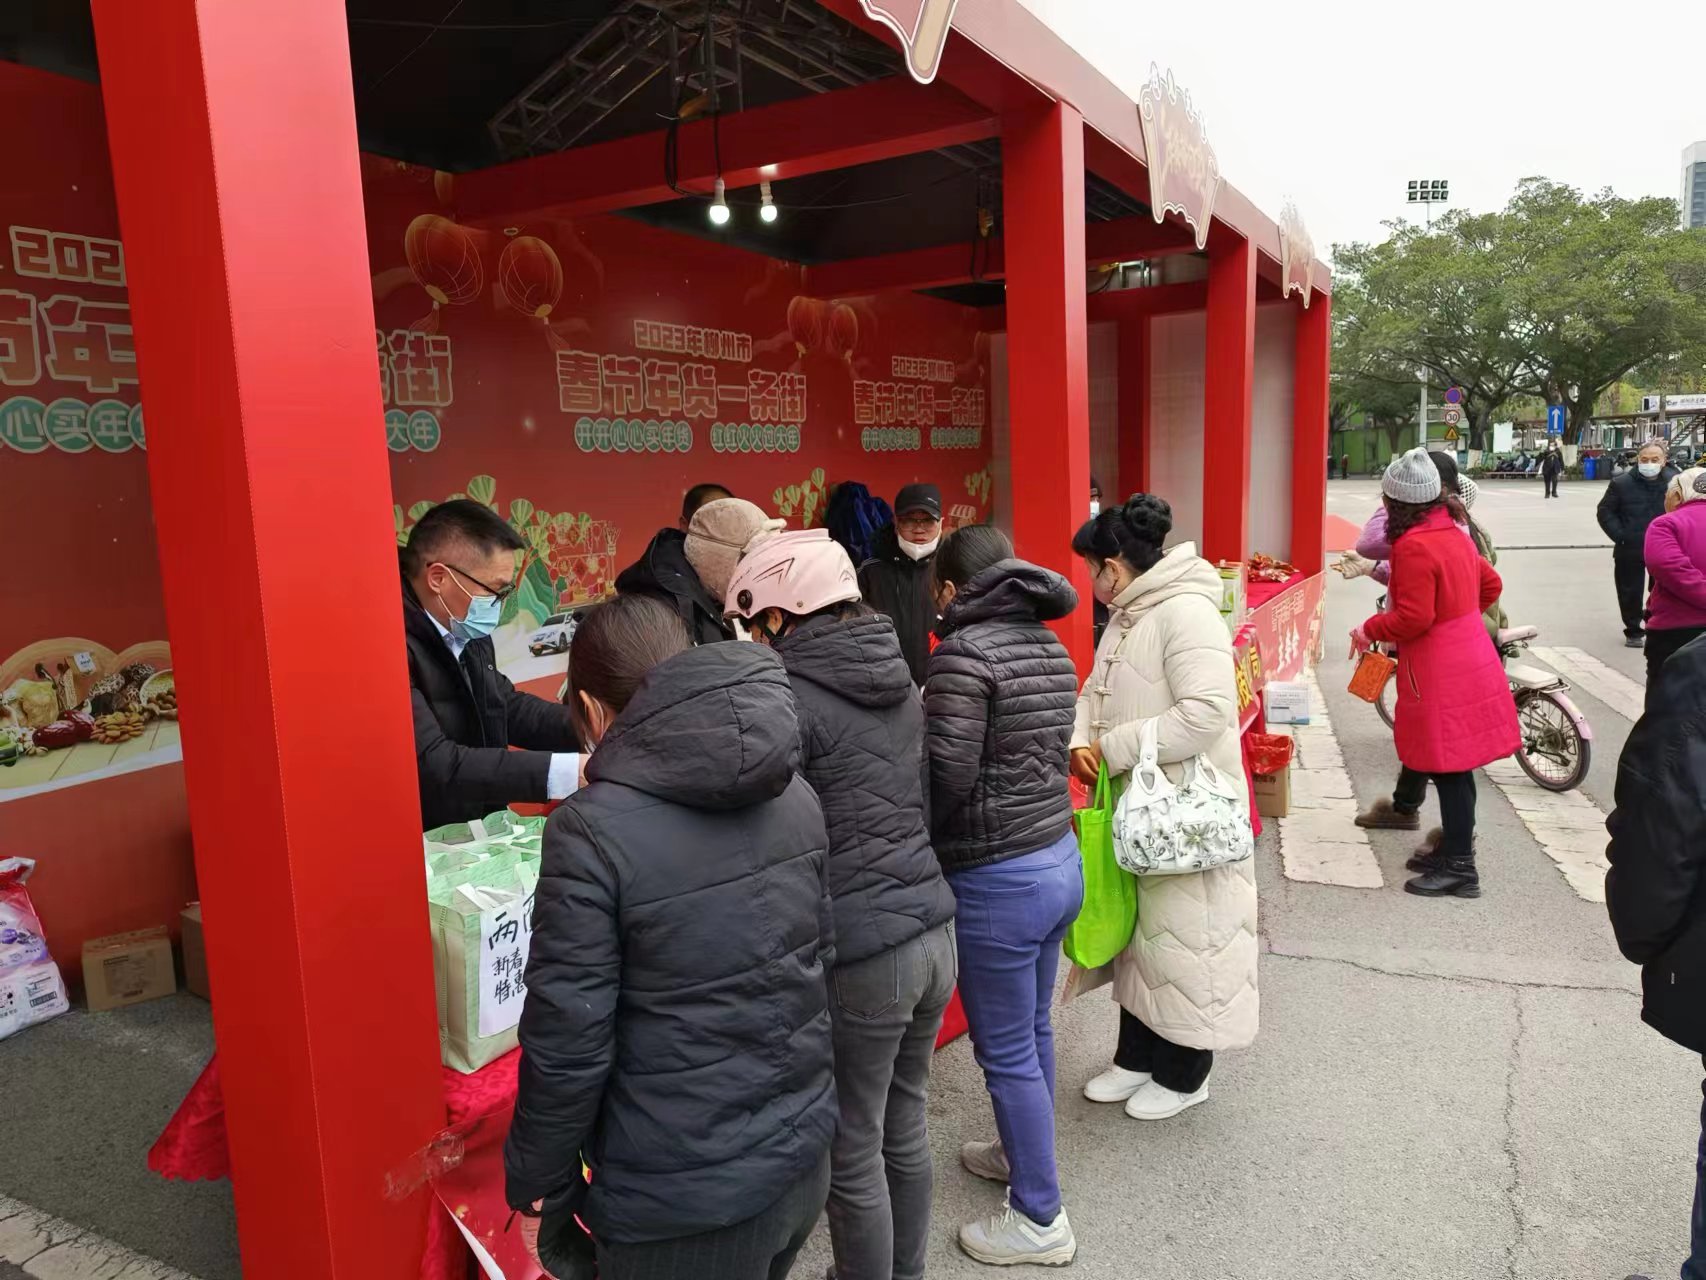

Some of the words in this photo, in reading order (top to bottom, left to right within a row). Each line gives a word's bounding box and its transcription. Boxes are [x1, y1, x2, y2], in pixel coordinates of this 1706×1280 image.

[633, 320, 752, 362] 2023年柳州市
[376, 329, 454, 407] 街
[556, 350, 807, 422] 春节年货一条街
[853, 380, 985, 425] 春节年货一条街
[1448, 413, 1458, 422] 30
[575, 418, 692, 451] 开开心心买年货
[711, 423, 800, 452] 红红火火过大年
